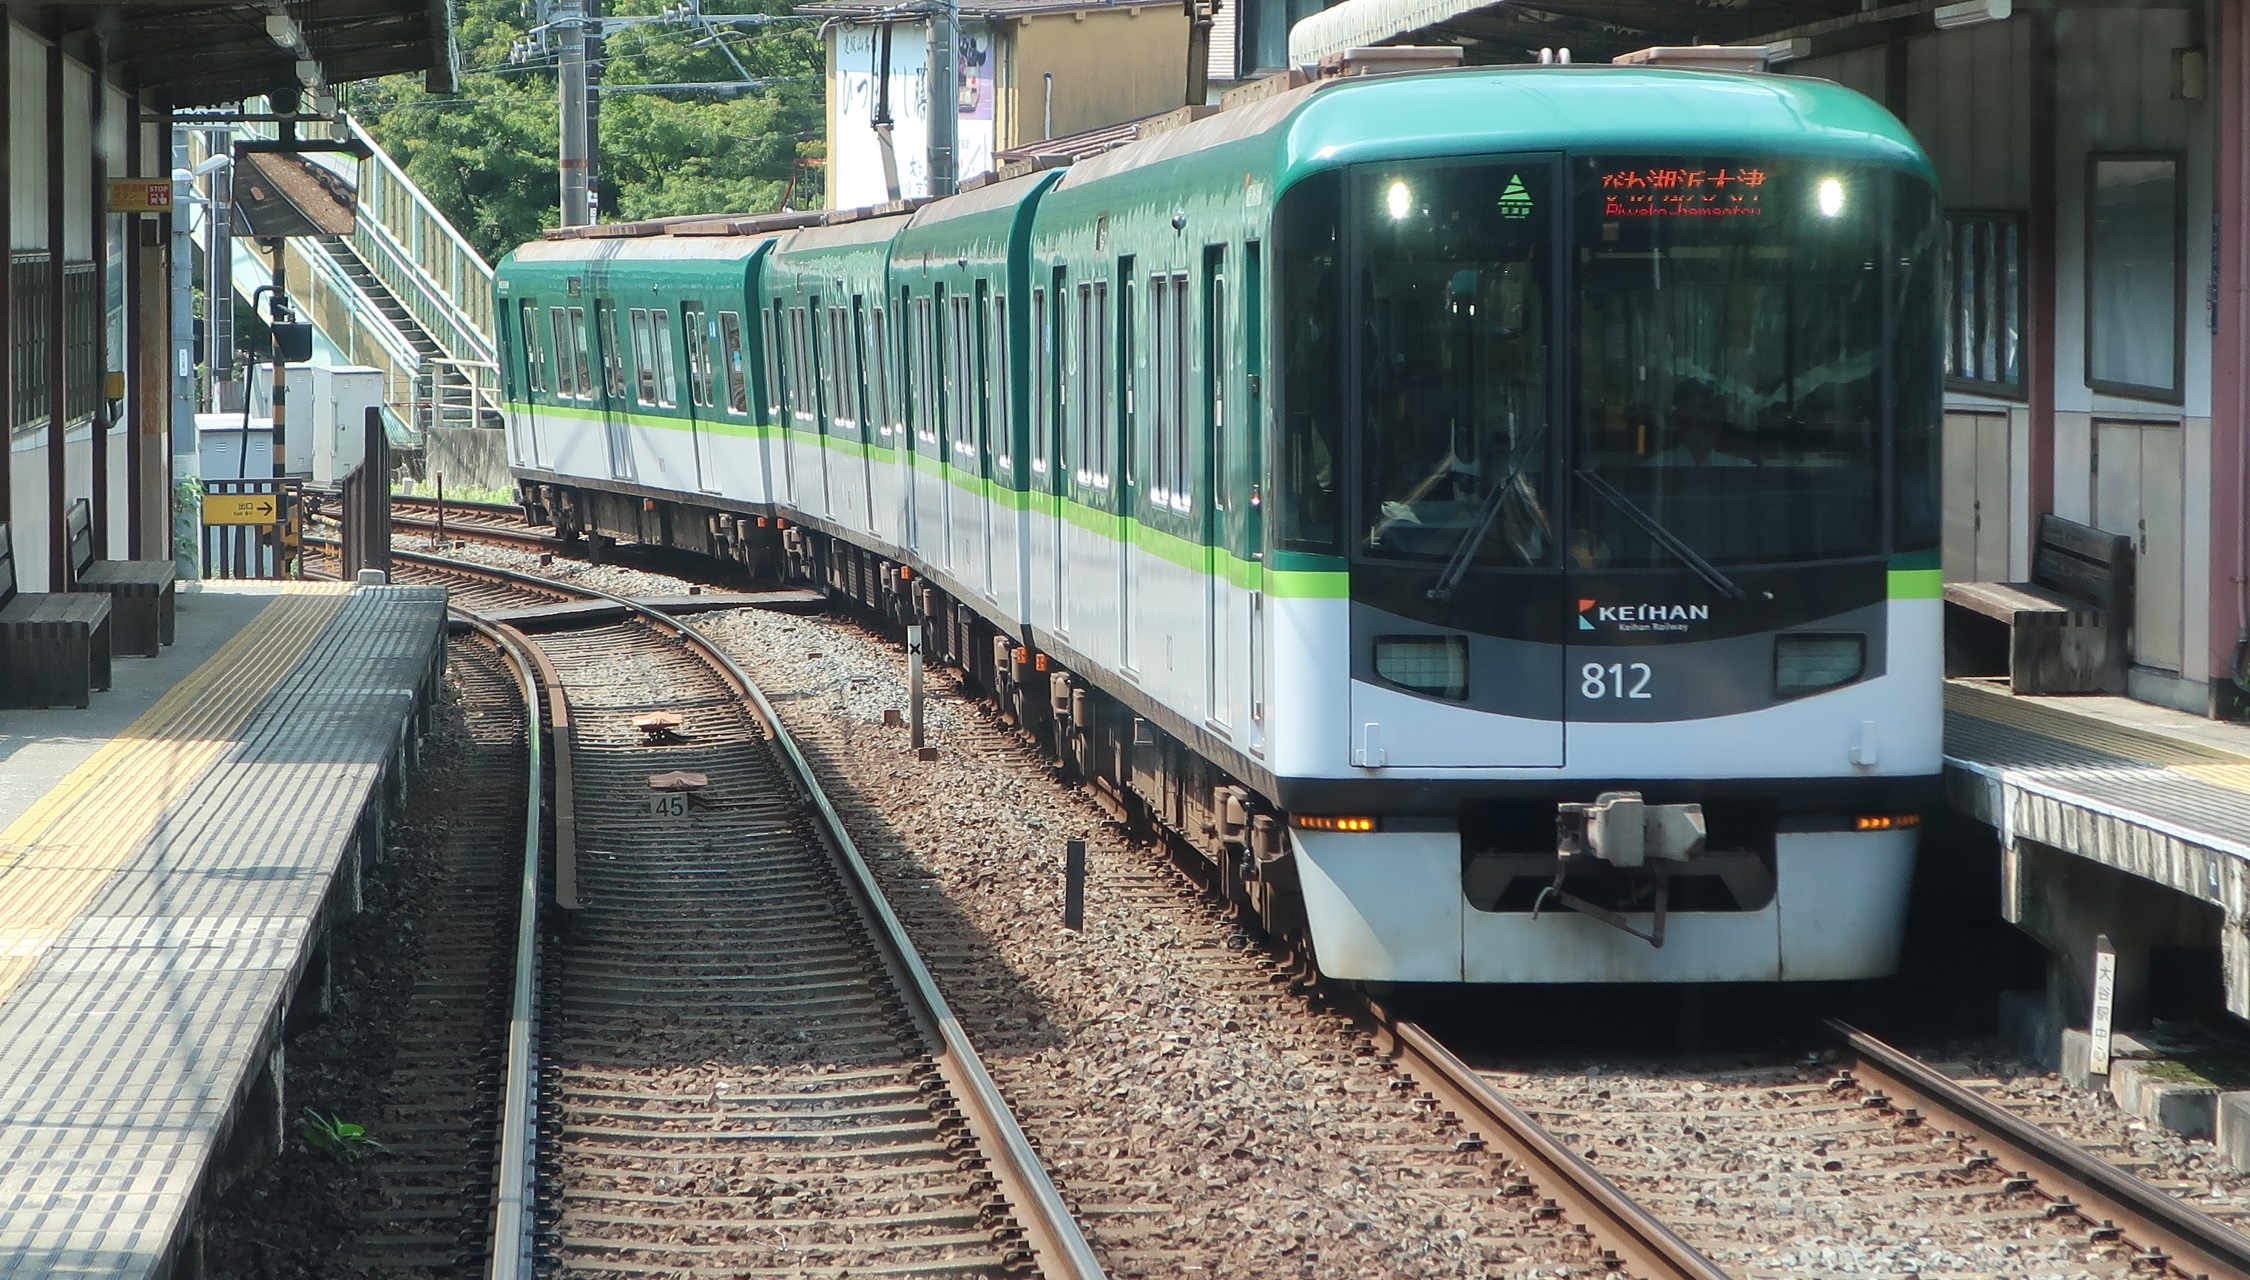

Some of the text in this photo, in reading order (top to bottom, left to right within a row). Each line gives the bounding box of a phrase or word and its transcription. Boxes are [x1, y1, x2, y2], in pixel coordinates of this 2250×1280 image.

[238, 502, 254, 511] 出口
[1599, 603, 1709, 622] KEIHAN
[1618, 622, 1690, 632] Keihan Railway
[1581, 662, 1653, 699] 812
[655, 796, 685, 818] 45
[2092, 966, 2112, 1061] 大谷駅中心
